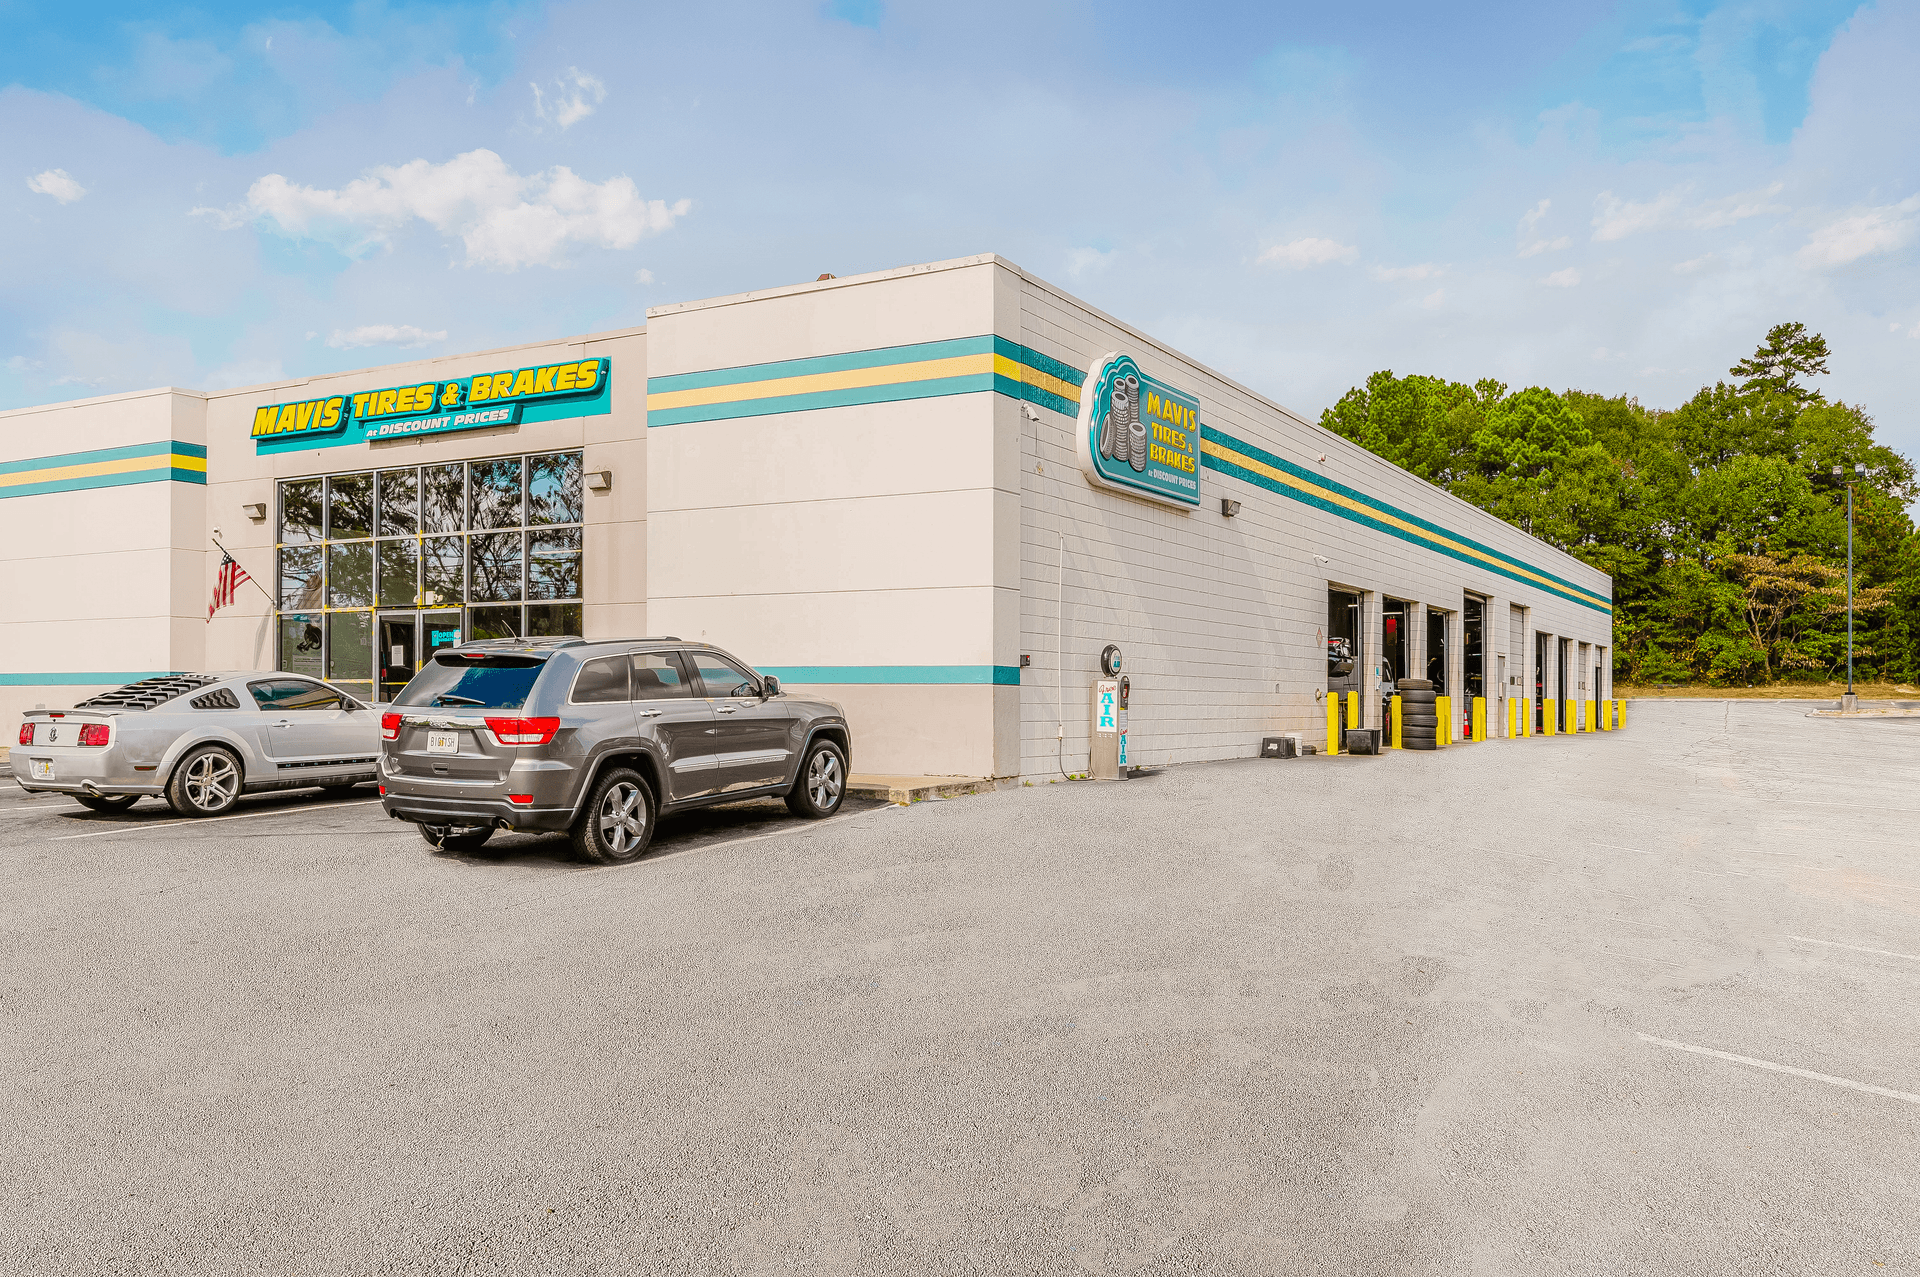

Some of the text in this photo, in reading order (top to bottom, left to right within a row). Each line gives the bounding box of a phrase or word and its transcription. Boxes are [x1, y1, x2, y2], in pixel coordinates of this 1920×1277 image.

[252, 359, 600, 437] MAVIS TIRES & BRAKES
[1147, 391, 1196, 432] MAVIS
[379, 416, 451, 436] DISCOUNT
[453, 409, 510, 426] PRICES
[1151, 421, 1193, 454] TIRES &
[1150, 442, 1195, 475] BRAKES
[1153, 469, 1178, 484] DISCOUNT
[1178, 476, 1196, 490] PRICES
[438, 631, 454, 639] OPEN
[1100, 692, 1115, 728] AIR
